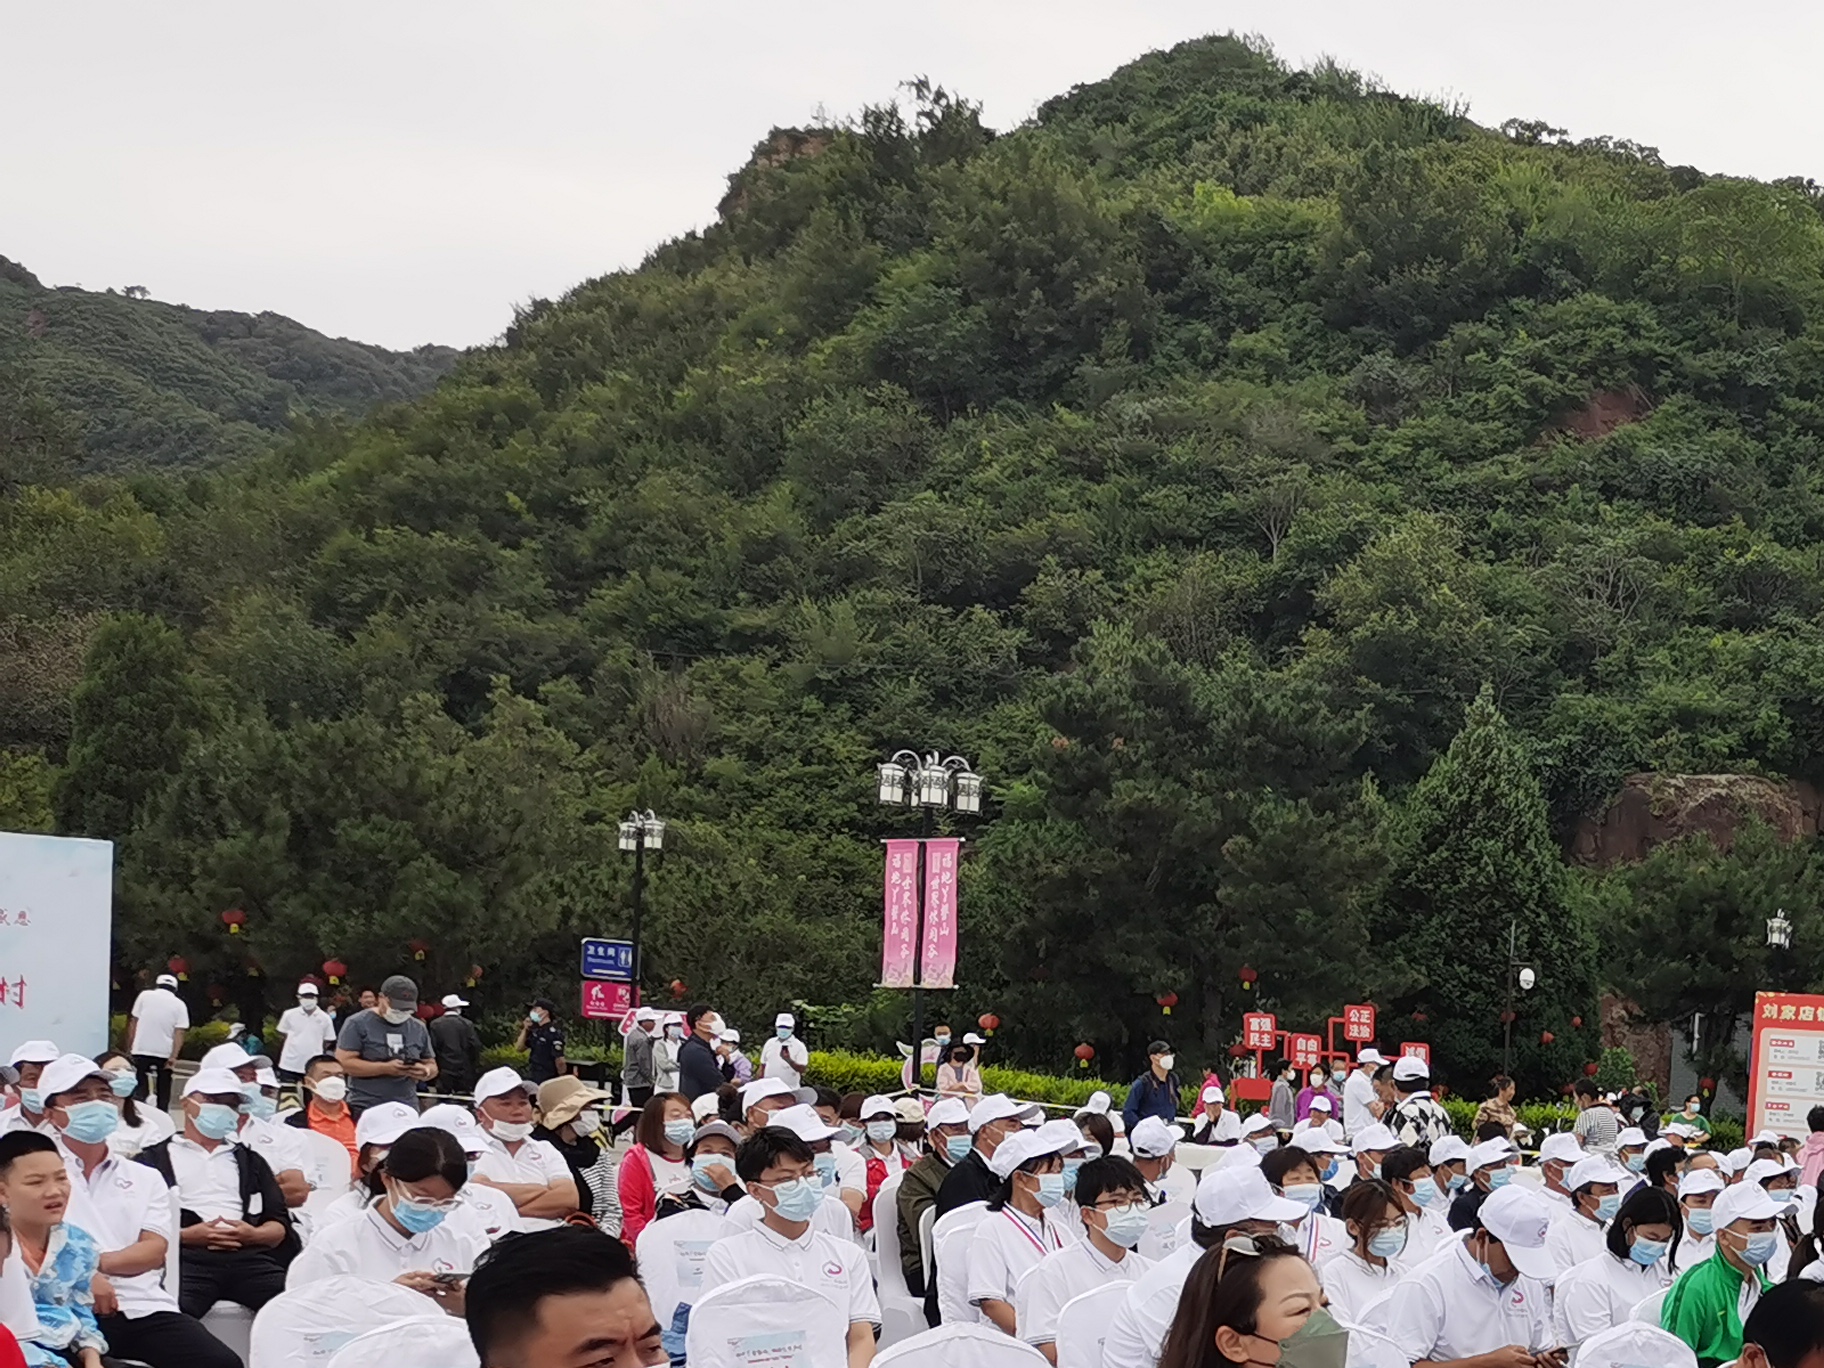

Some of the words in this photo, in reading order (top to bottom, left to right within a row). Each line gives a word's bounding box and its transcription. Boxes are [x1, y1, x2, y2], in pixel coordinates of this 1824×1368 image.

[1350, 1010, 1372, 1023] 公正
[1250, 1018, 1272, 1032] 富强
[1349, 1025, 1371, 1038] 法治
[1249, 1033, 1272, 1047] 民主
